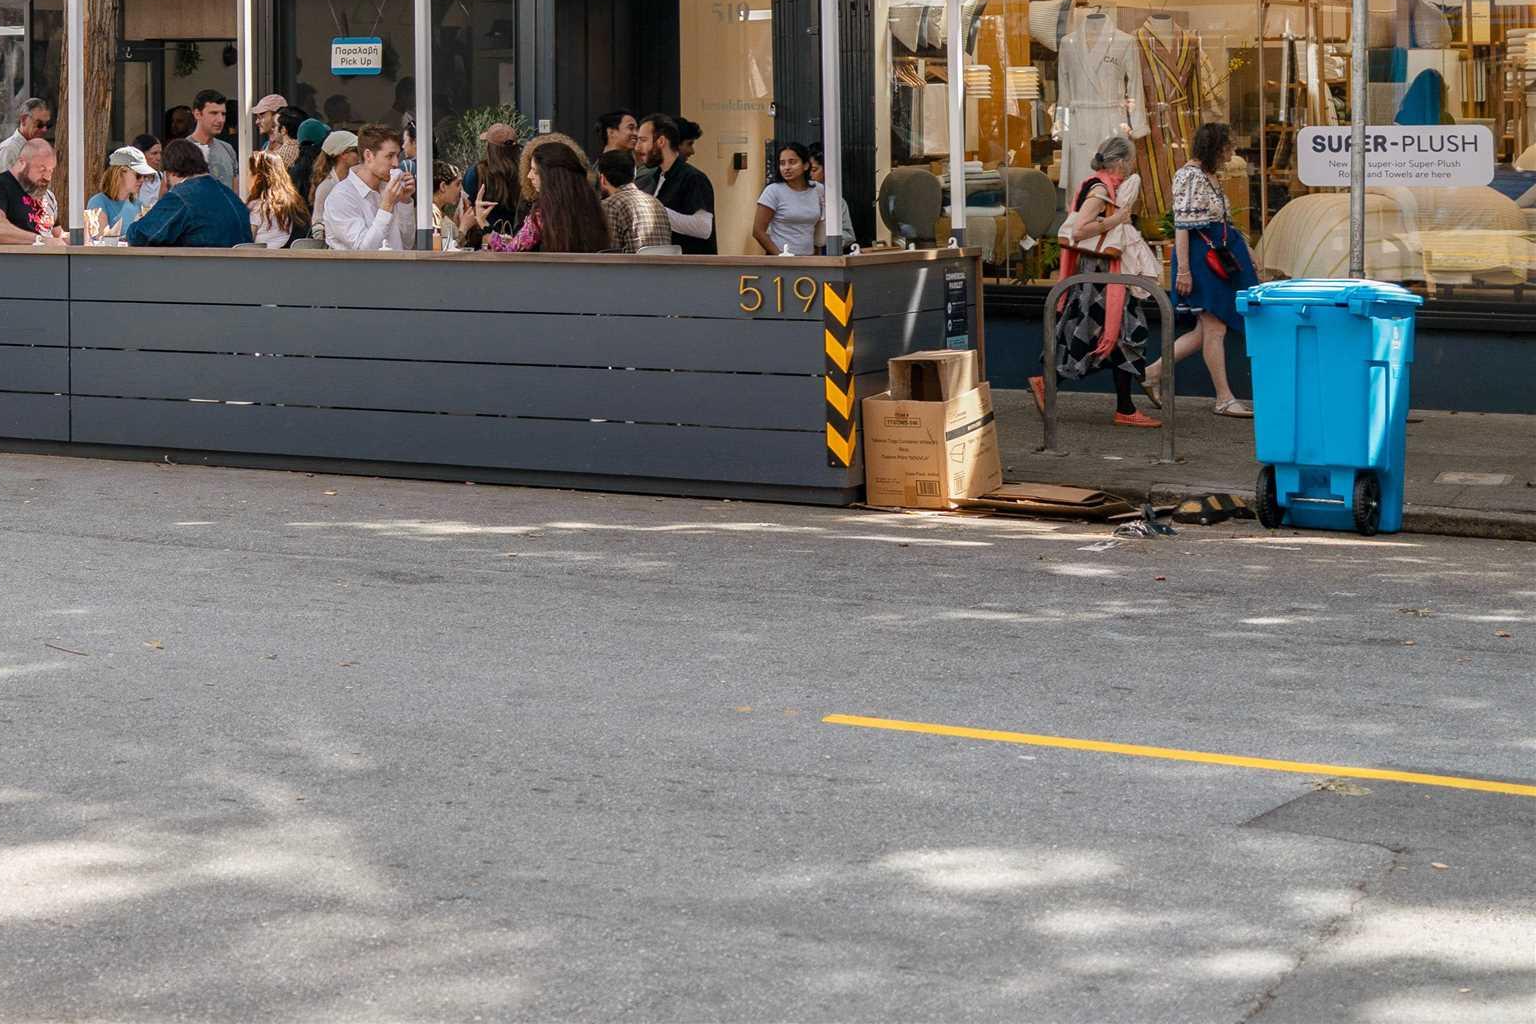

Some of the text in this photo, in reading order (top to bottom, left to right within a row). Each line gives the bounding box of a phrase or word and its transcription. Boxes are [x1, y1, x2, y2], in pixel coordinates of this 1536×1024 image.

[335, 45, 378, 56] Παραλαβή
[341, 57, 372, 67] Pick Up
[1328, 160, 1348, 168] New
[1385, 170, 1413, 178] Towels
[739, 275, 817, 313] 519
